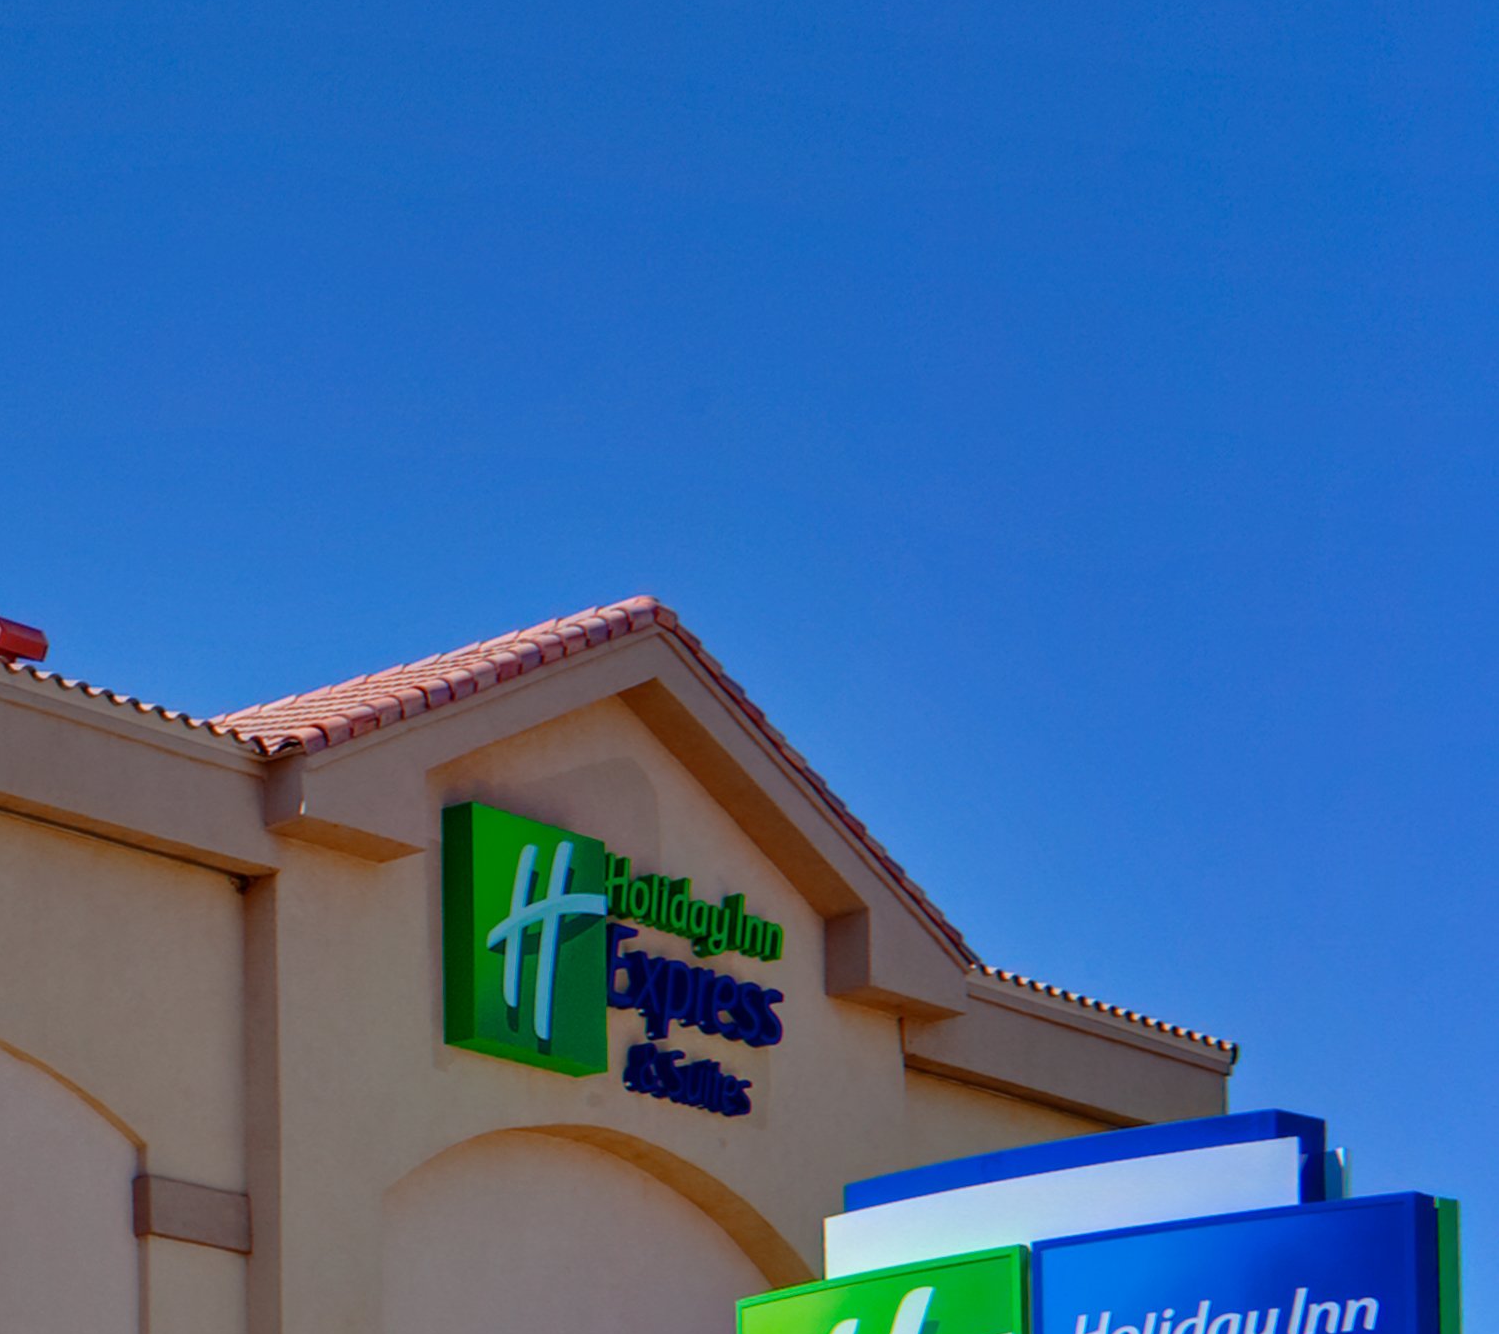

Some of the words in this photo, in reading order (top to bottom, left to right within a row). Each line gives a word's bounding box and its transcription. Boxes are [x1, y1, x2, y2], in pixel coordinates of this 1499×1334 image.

[605, 853, 732, 957] Holiday
[723, 893, 784, 961] Inn
[606, 923, 784, 1047] Express
[623, 1043, 657, 1092] &
[647, 1050, 752, 1117] Suites
